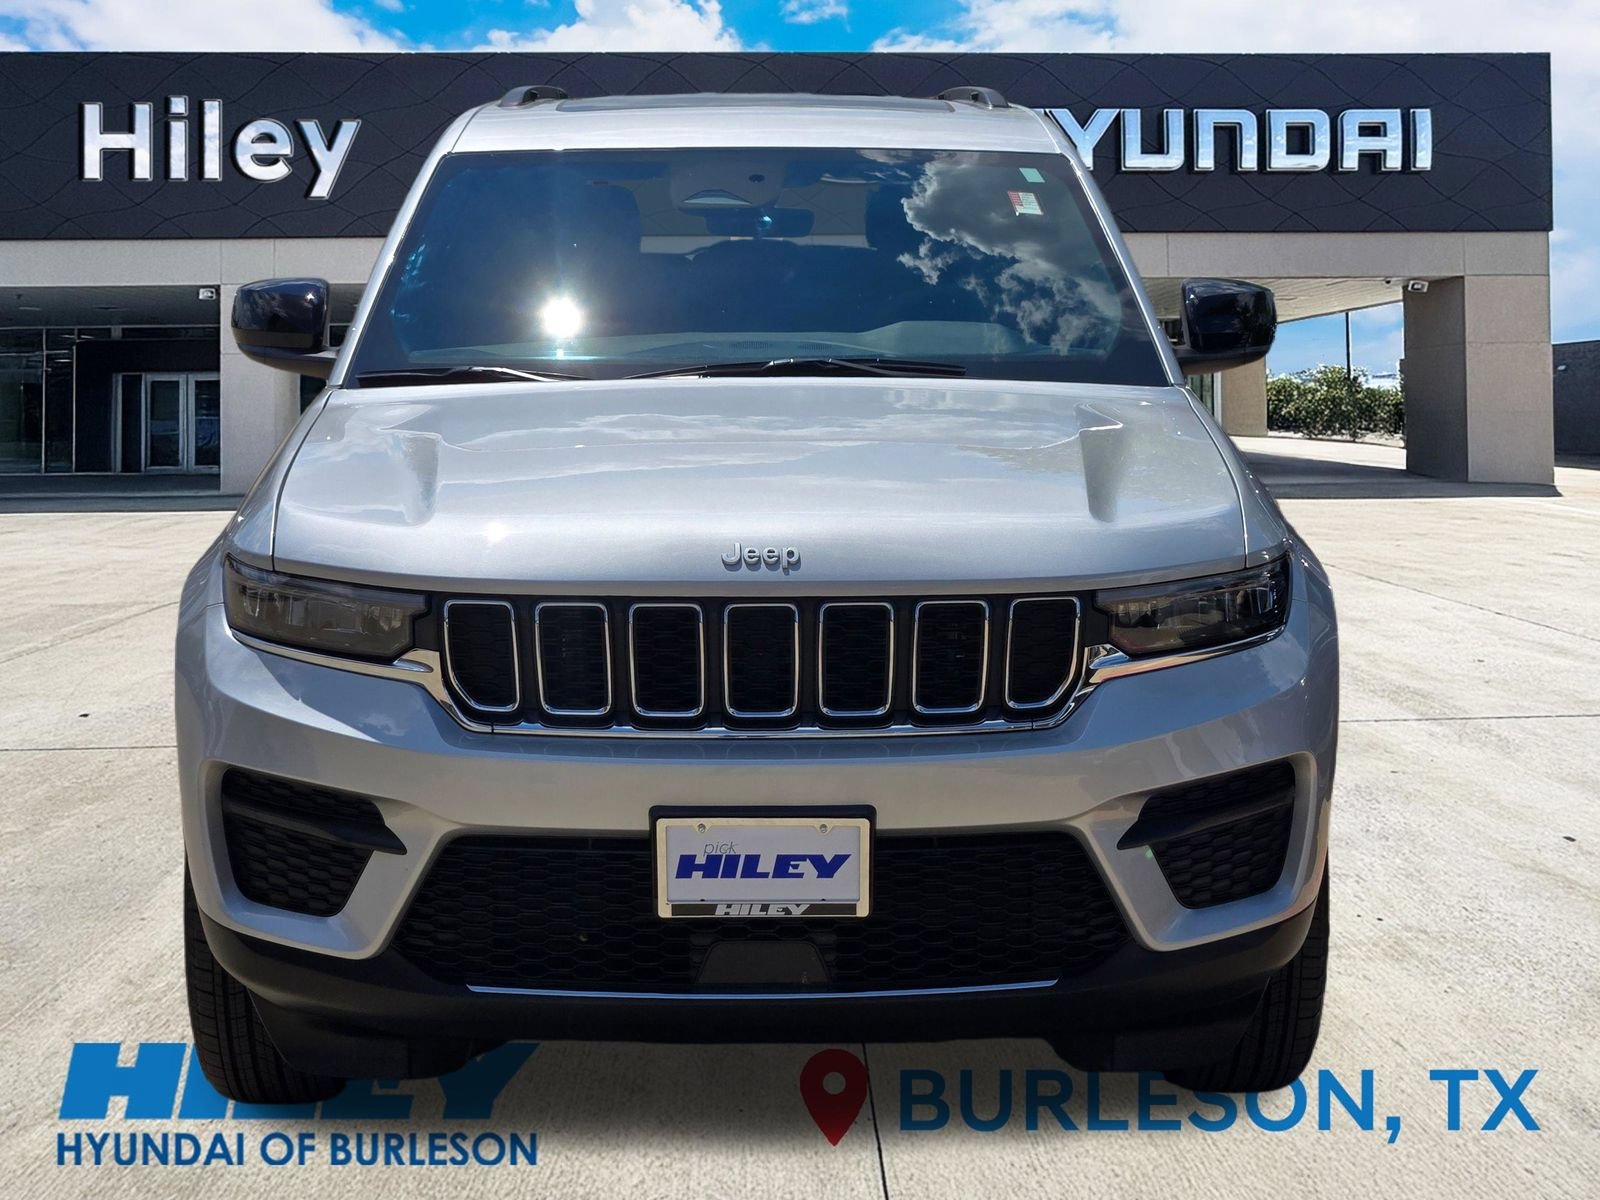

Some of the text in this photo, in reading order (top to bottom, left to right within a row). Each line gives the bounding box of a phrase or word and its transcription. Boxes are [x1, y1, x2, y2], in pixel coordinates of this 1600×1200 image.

[80, 95, 362, 200] Hiley
[1032, 107, 1432, 171] YUNDAI
[721, 542, 801, 574] Jeep
[703, 841, 737, 856] pick
[675, 854, 851, 879] HILEY
[714, 903, 810, 916] HILEY
